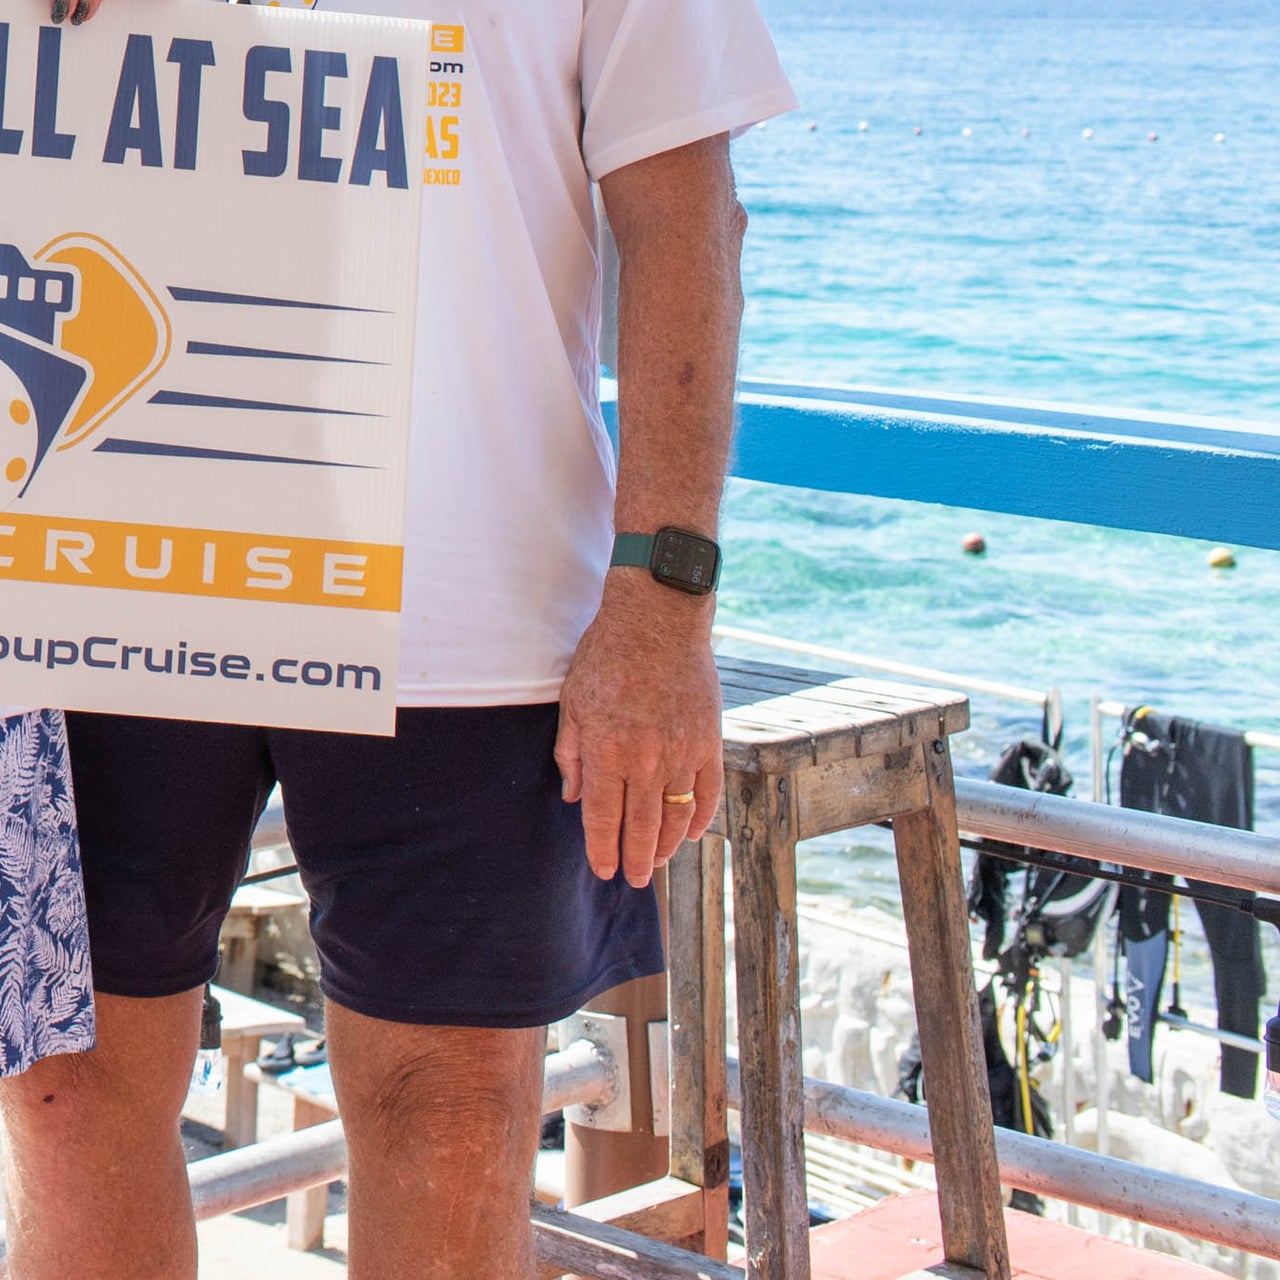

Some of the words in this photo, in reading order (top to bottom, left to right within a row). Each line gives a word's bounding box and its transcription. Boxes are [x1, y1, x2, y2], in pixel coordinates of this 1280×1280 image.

[101, 33, 217, 172] AT
[241, 44, 410, 191] SEA
[423, 168, 461, 186] EXICO
